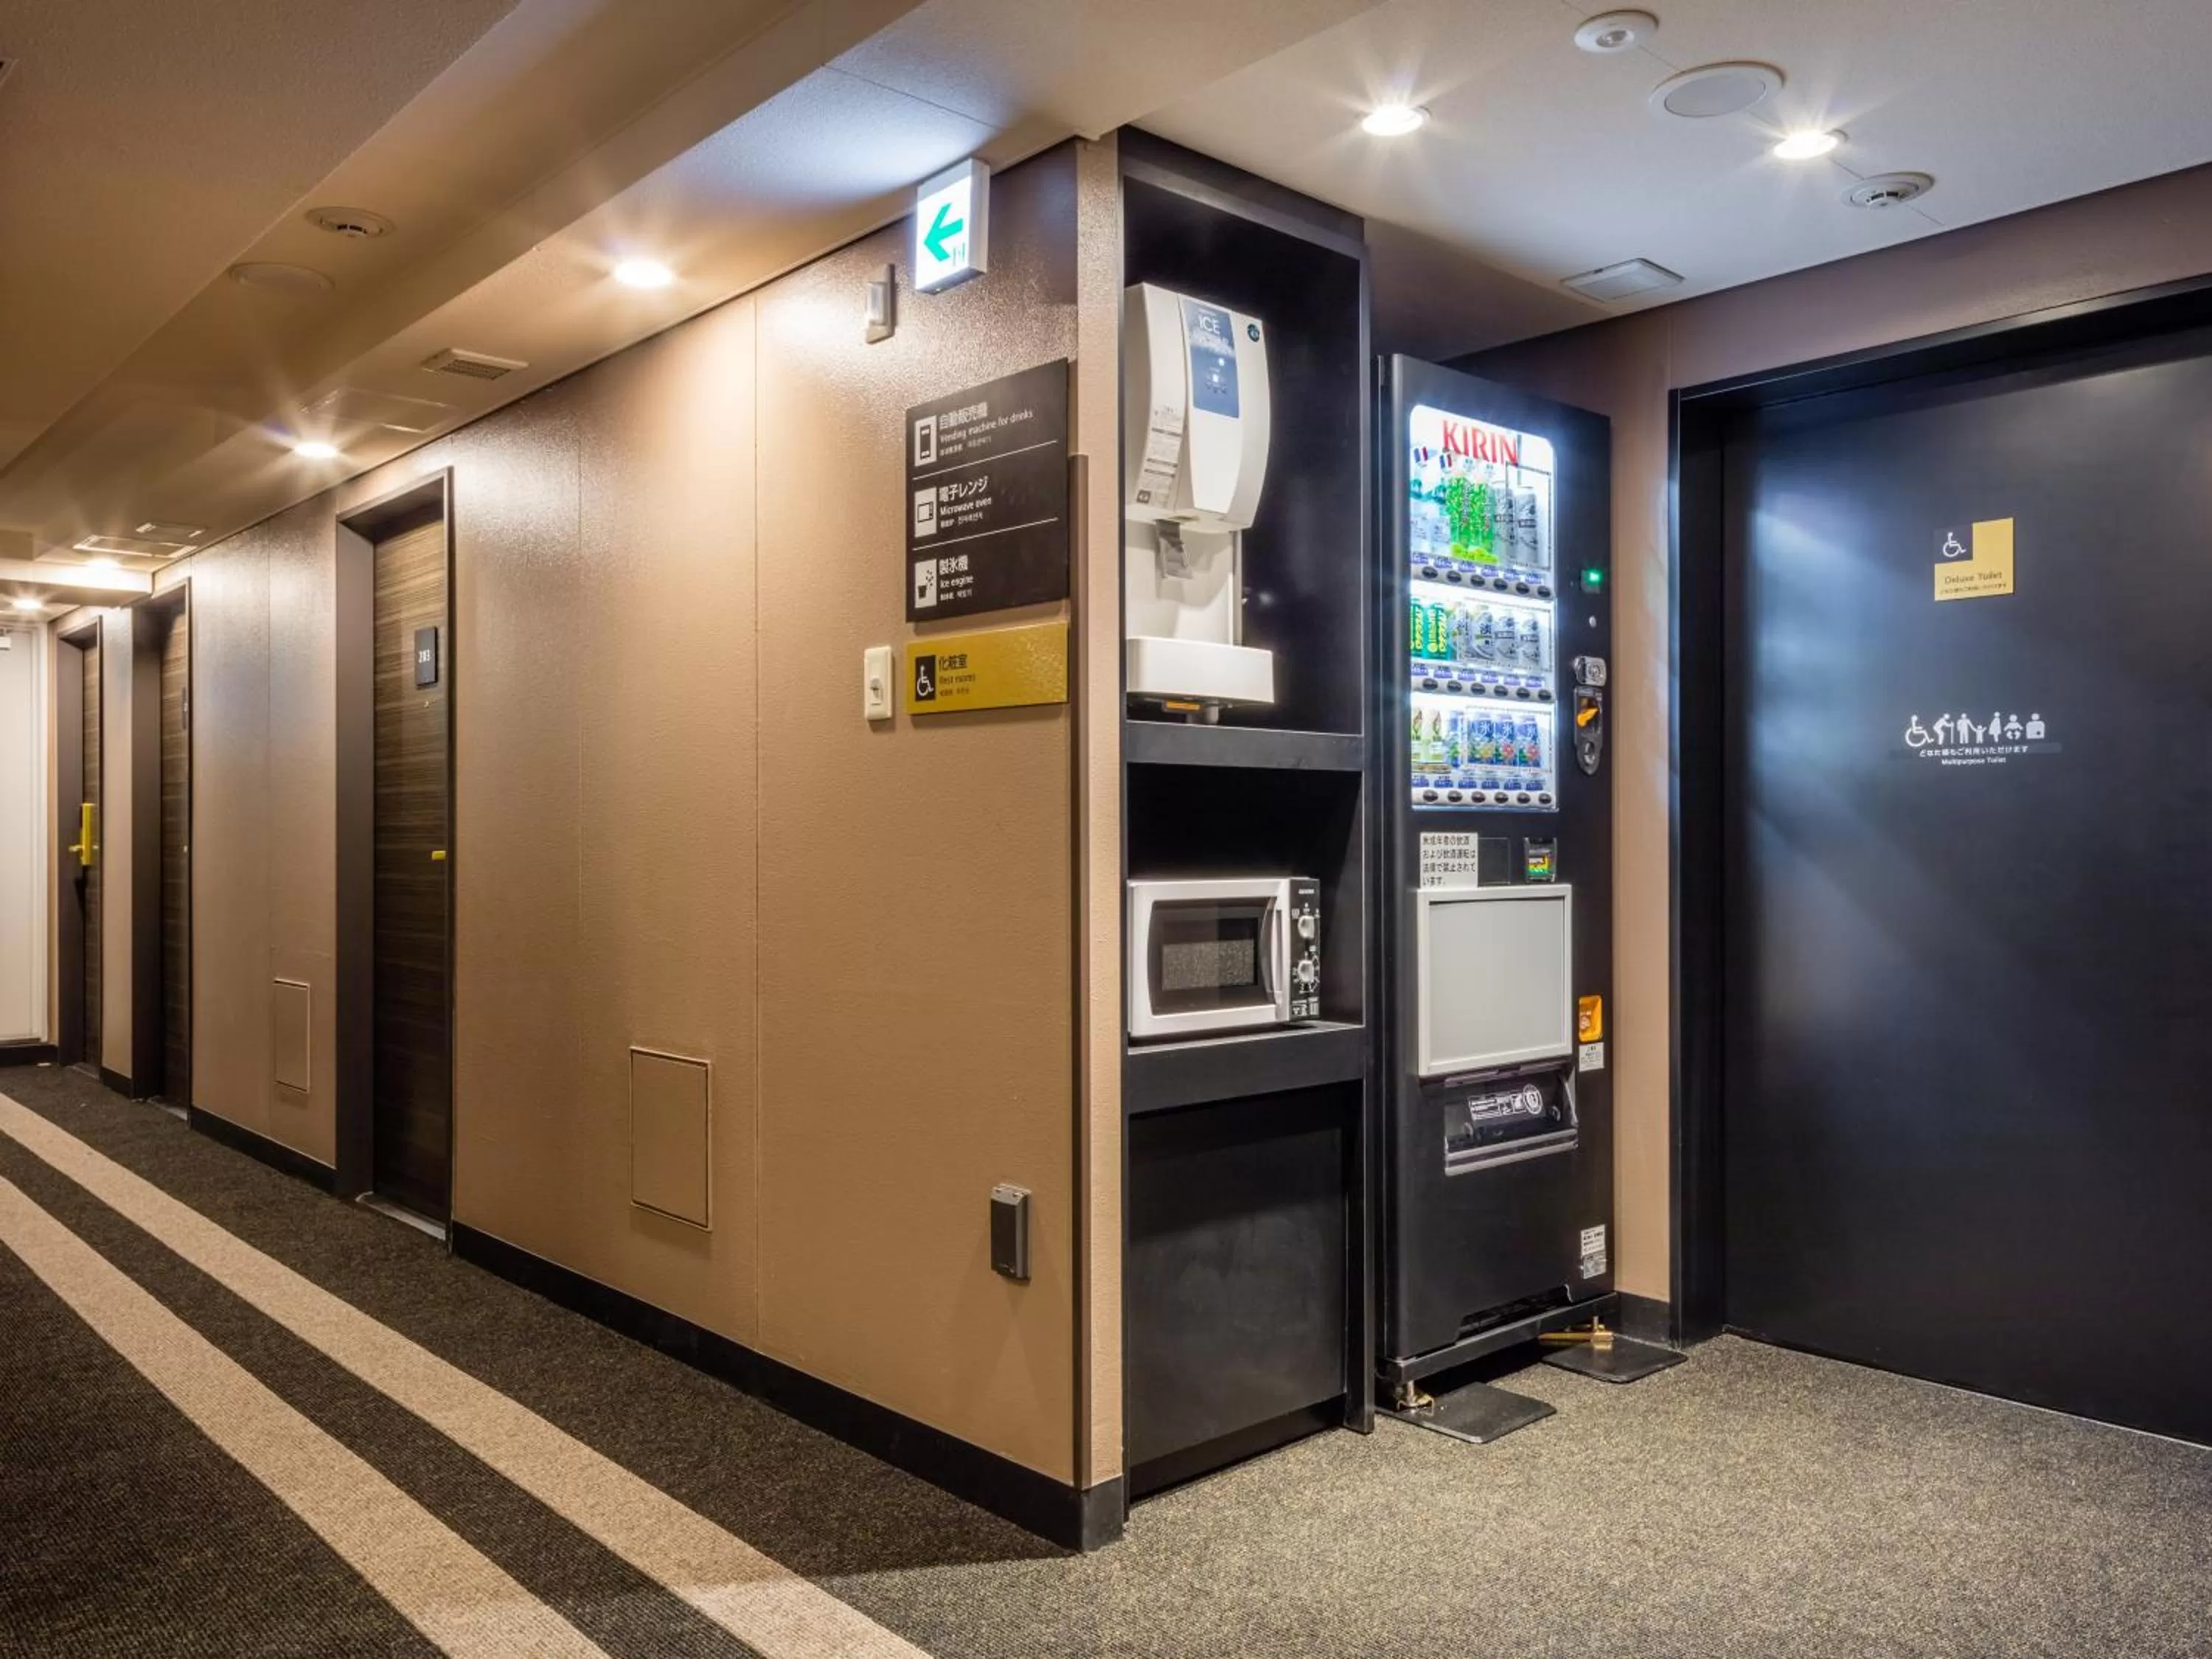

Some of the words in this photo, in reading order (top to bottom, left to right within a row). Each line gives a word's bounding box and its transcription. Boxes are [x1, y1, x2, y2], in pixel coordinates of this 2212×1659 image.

[1199, 315, 1220, 334] ICE
[998, 416, 1009, 426] for
[1009, 408, 1033, 423] drinks
[1442, 420, 1518, 465] KIRIN
[939, 476, 989, 502] 電子レンジ
[940, 502, 974, 515] Microwave
[975, 497, 992, 507] oven
[1944, 576, 1975, 585] Deluxe
[1978, 571, 2003, 580] Toilet
